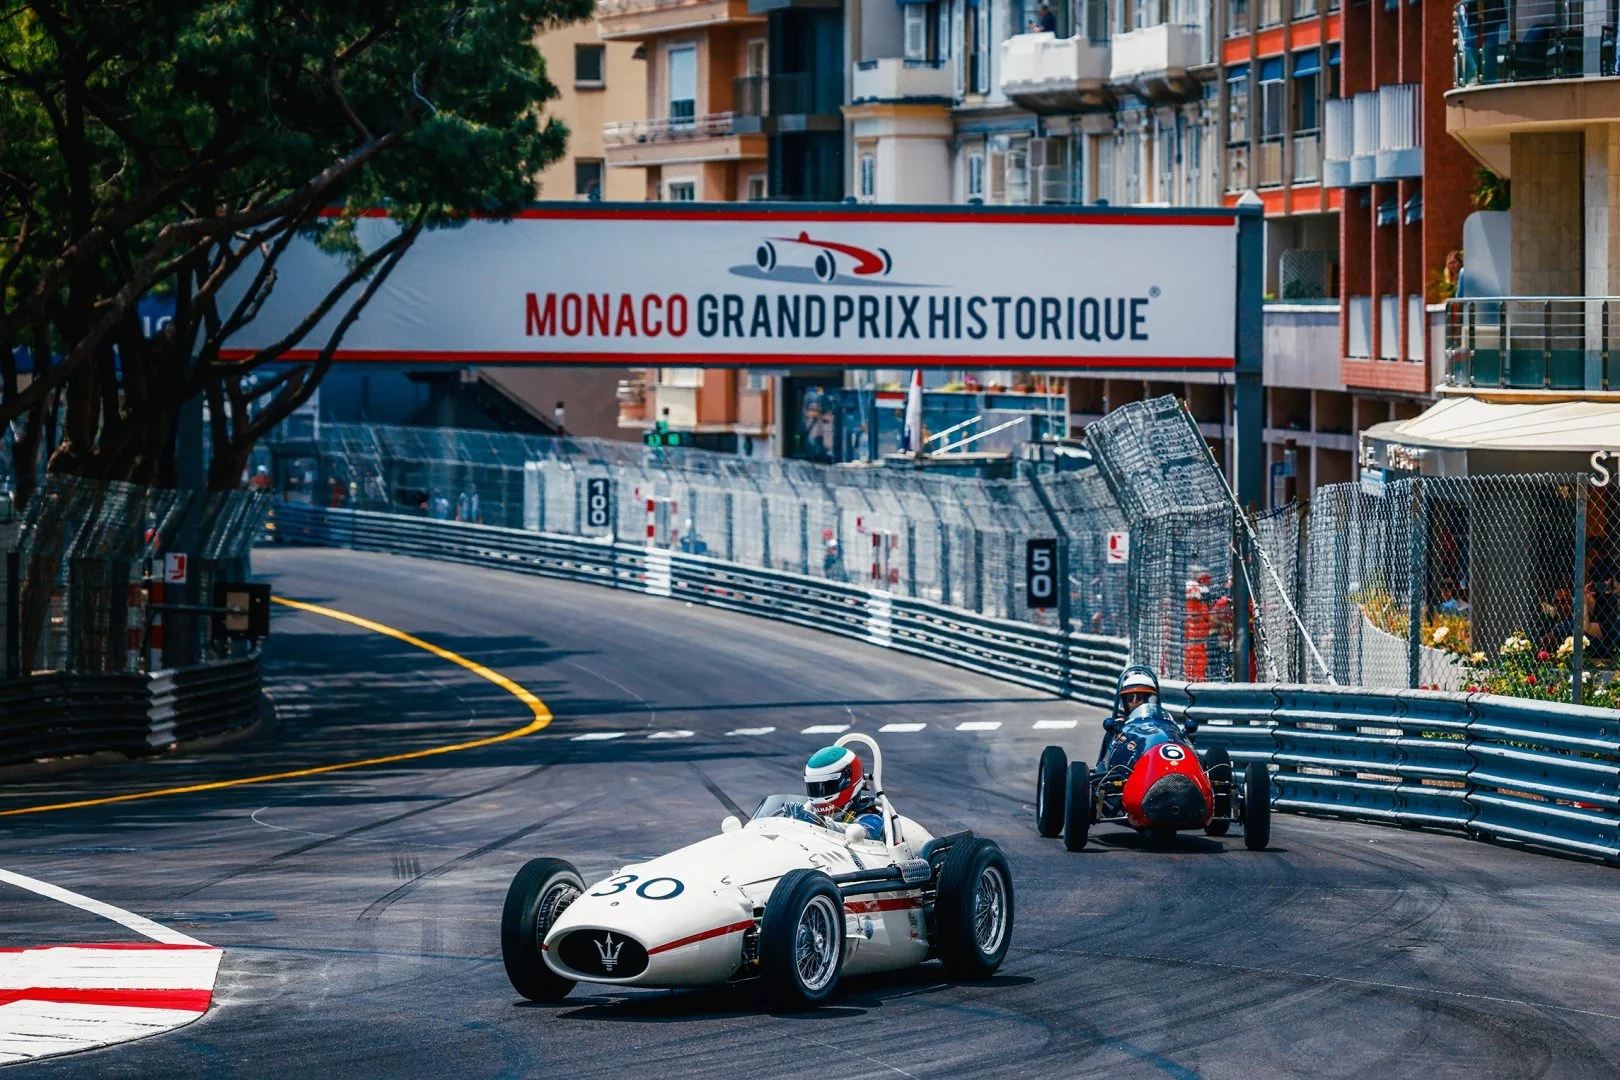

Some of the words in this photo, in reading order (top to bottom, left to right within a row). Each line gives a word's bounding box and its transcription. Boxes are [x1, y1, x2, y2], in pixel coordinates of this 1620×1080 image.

[525, 292, 688, 337] MONACO
[696, 292, 826, 338] GRAND
[833, 293, 927, 339] PRIX
[591, 480, 606, 525] 100
[1032, 549, 1052, 598] 50
[1161, 745, 1183, 760] 6
[591, 873, 685, 900] 30
